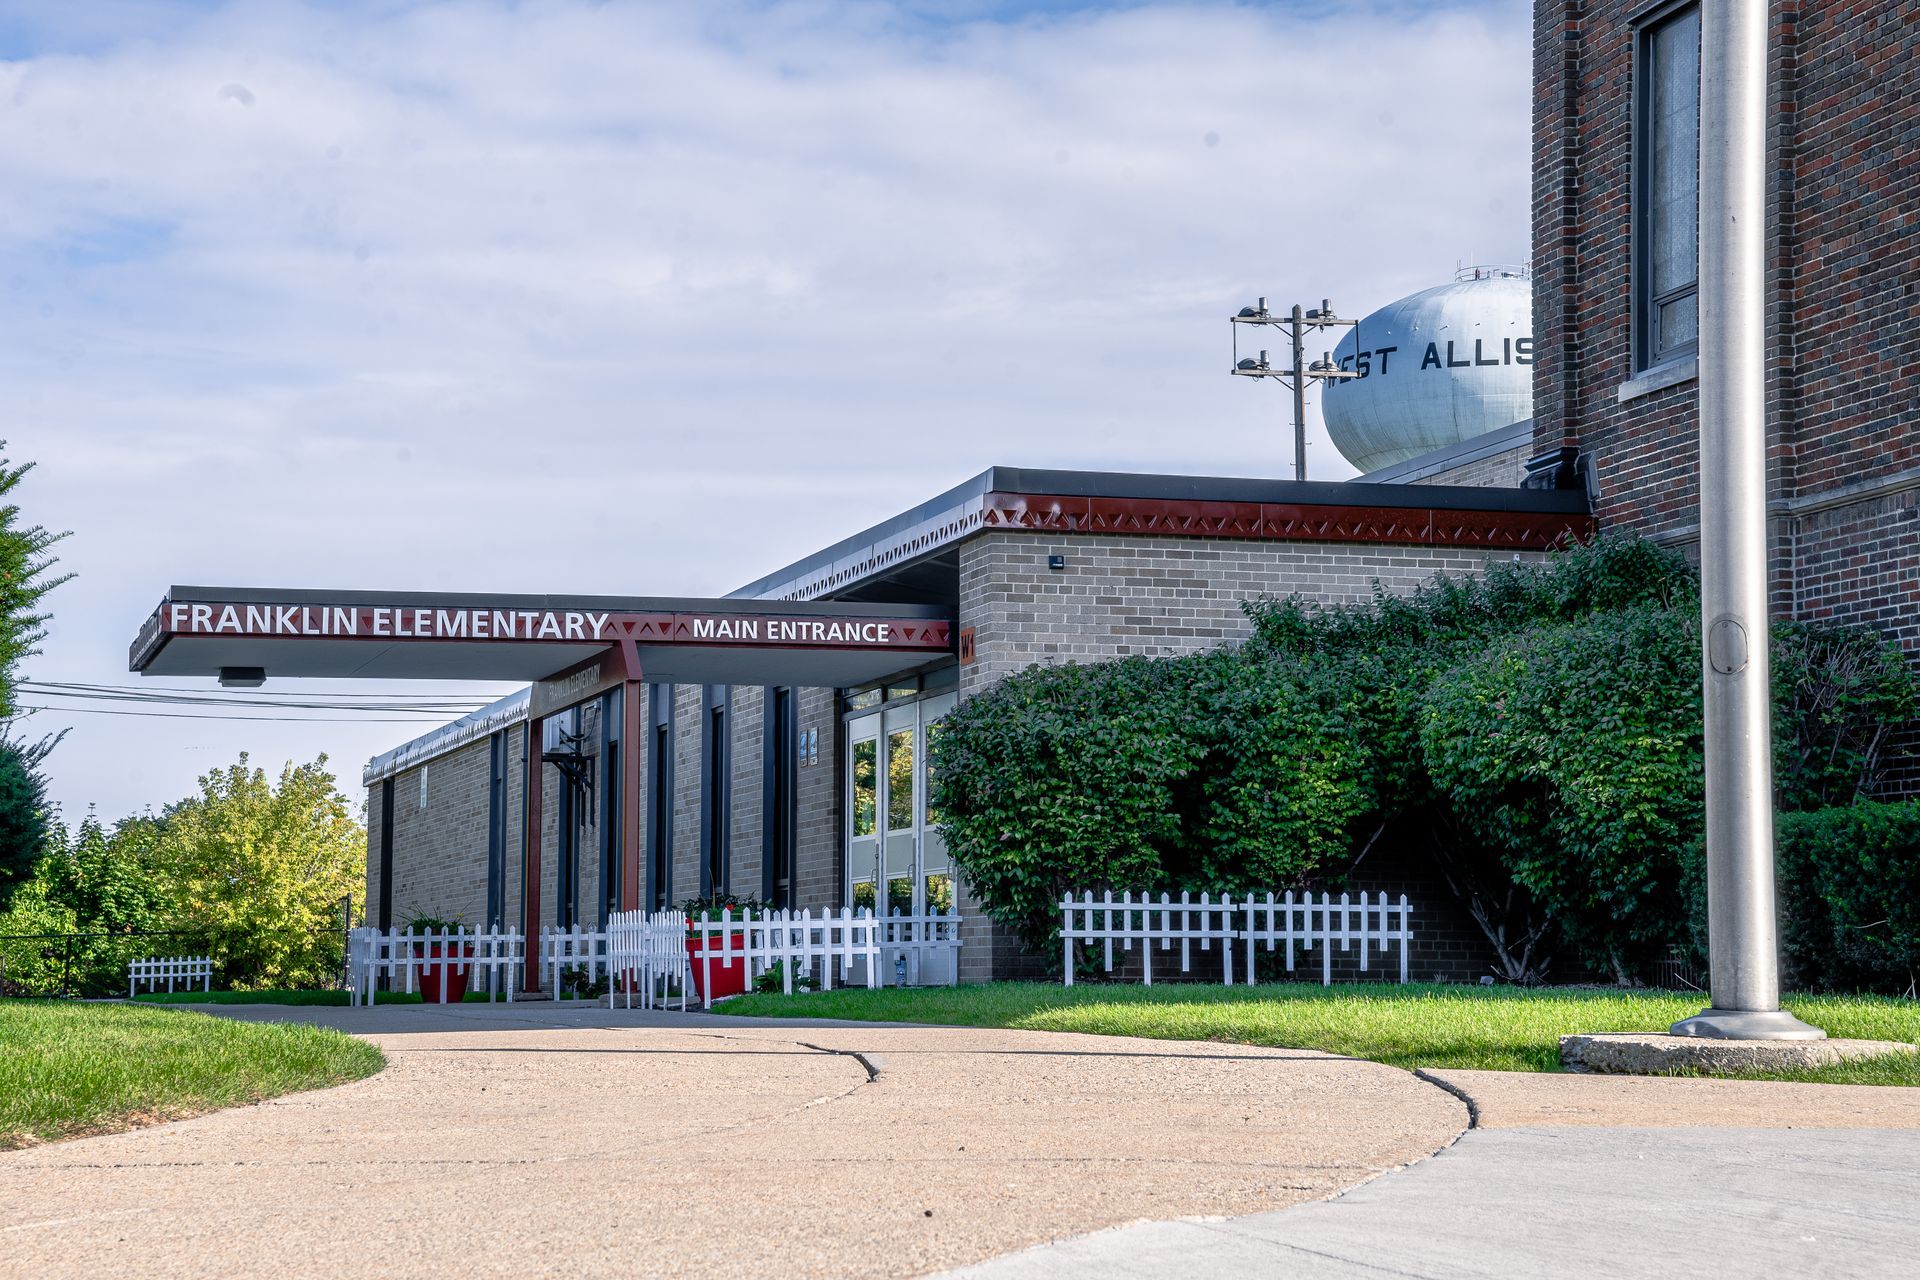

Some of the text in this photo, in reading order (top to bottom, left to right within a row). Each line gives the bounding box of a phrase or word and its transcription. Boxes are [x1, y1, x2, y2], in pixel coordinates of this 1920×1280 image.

[1420, 337, 1533, 370] ALLIS
[170, 603, 610, 640] FRANKLIN ELEMENTARY
[693, 618, 889, 643] MAIN ENTRANCE
[961, 633, 974, 659] W1
[570, 663, 601, 694] ELEMENTARY
